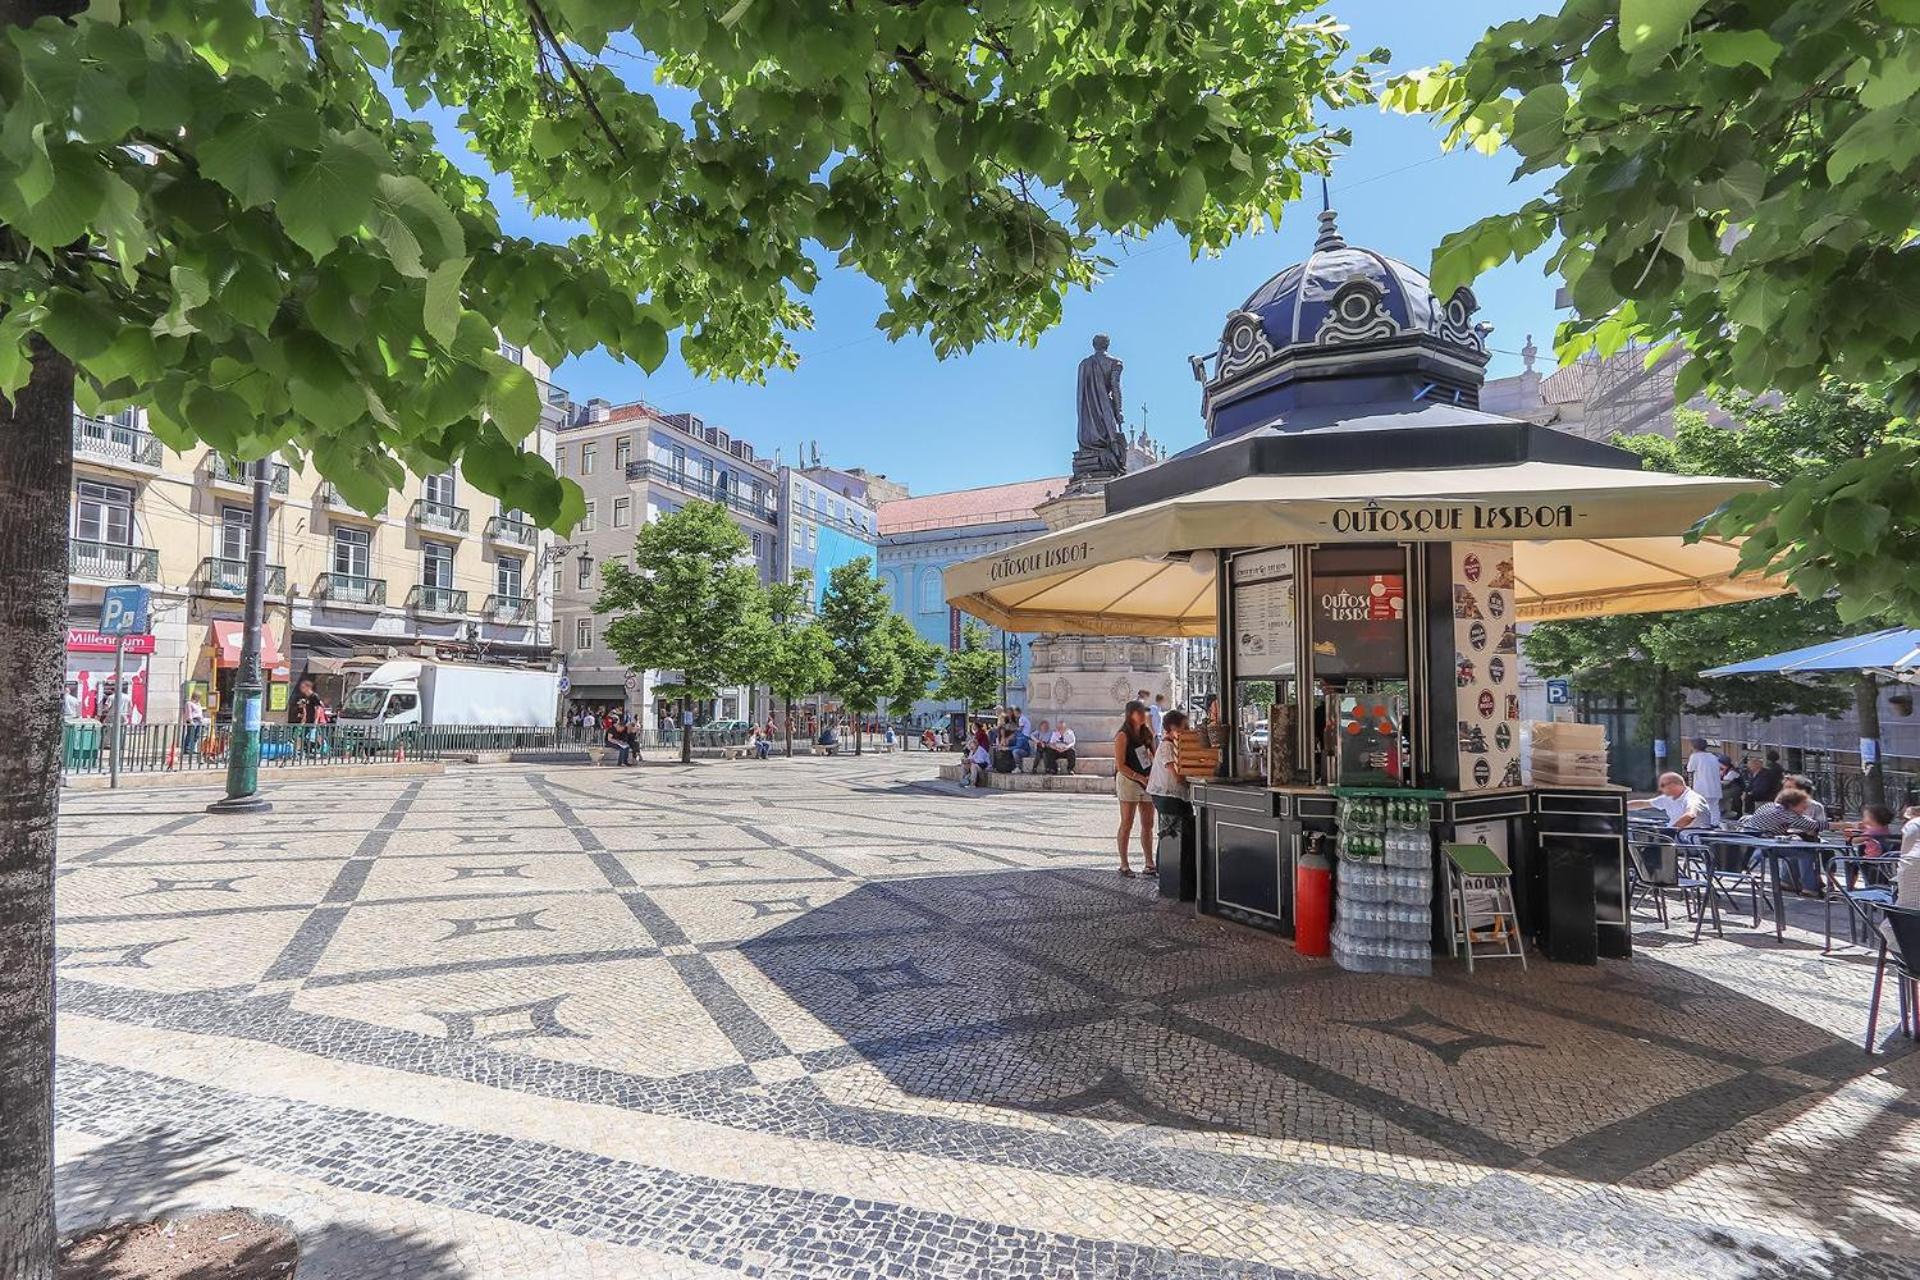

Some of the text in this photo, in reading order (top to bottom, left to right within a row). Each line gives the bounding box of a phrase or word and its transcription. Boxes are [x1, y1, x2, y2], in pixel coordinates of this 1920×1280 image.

[1474, 504, 1574, 529] LISBOA
[1045, 542, 1088, 568] LISBOA
[68, 630, 145, 646] Millennum
[1551, 689, 1563, 703] P
